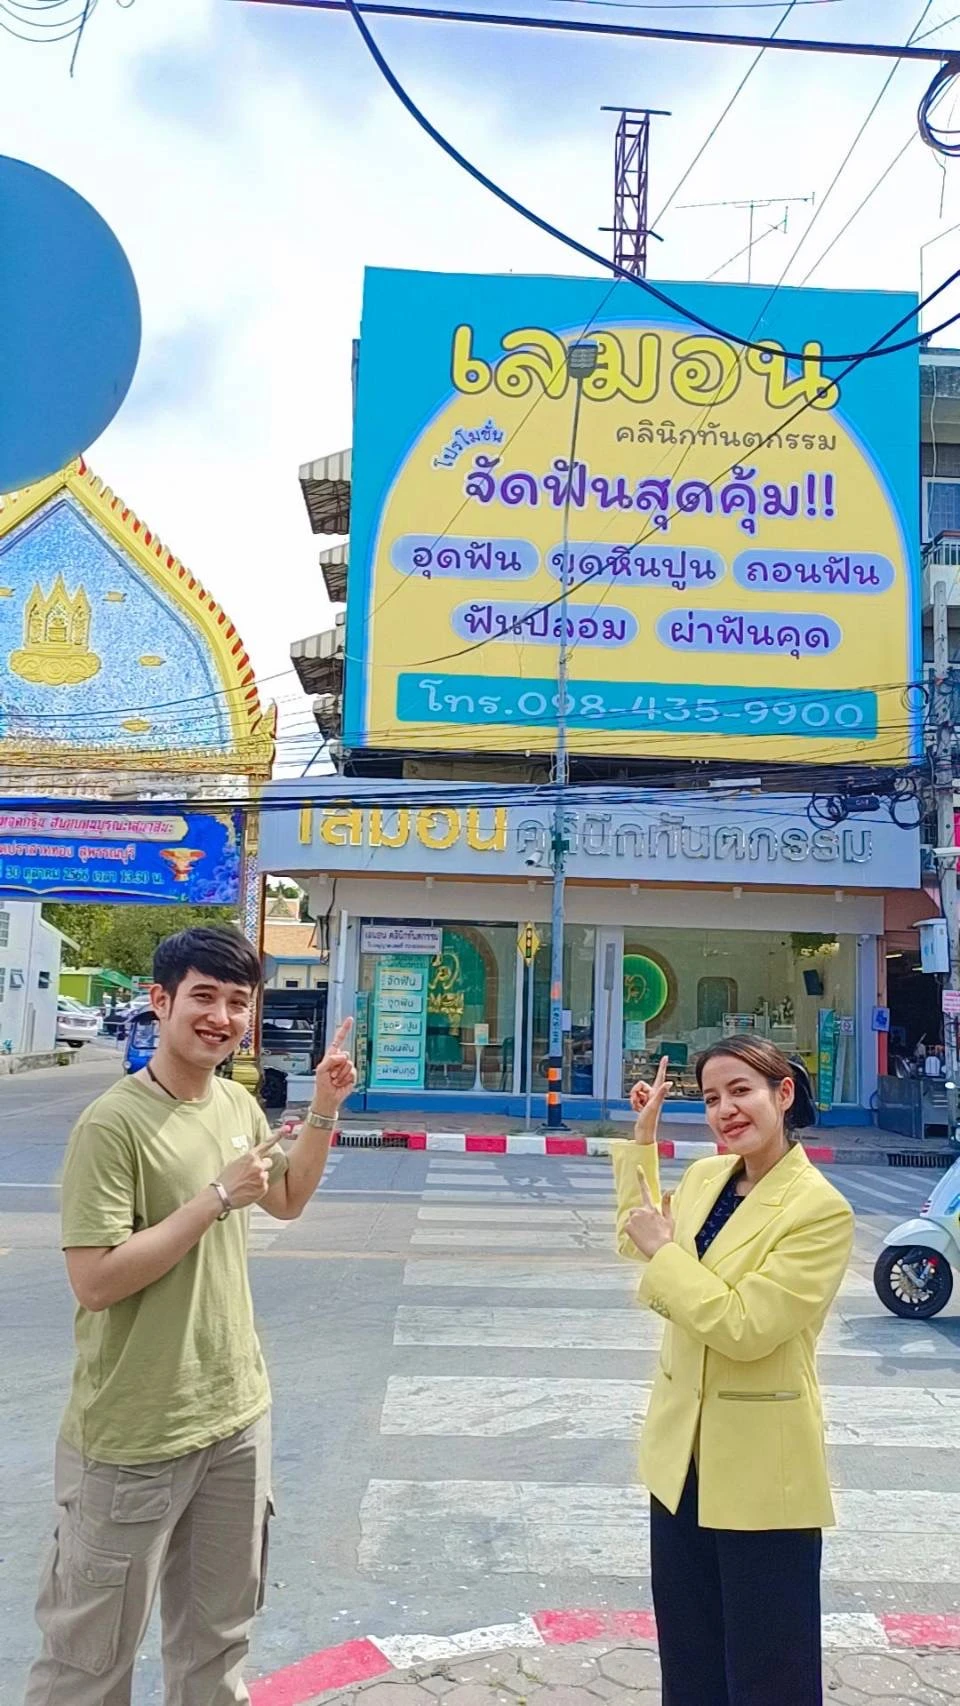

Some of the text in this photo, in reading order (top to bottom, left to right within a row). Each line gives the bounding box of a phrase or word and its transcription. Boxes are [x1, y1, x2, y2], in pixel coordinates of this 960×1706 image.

[450, 322, 842, 411] เลมอน
[433, 419, 503, 468] โปรโมชั่น
[616, 418, 837, 452] คลินิกทันตกรรม
[464, 456, 835, 535] จัดฟันสุดคุ้ม!!
[412, 541, 881, 591] อุดฟัน ขูดหินปูน ถอนฟัน
[464, 604, 831, 659] ฟันปลอม ผ่าฟันคุด
[419, 679, 864, 729] โทร.098-435-9900
[298, 799, 508, 852] เลมอน
